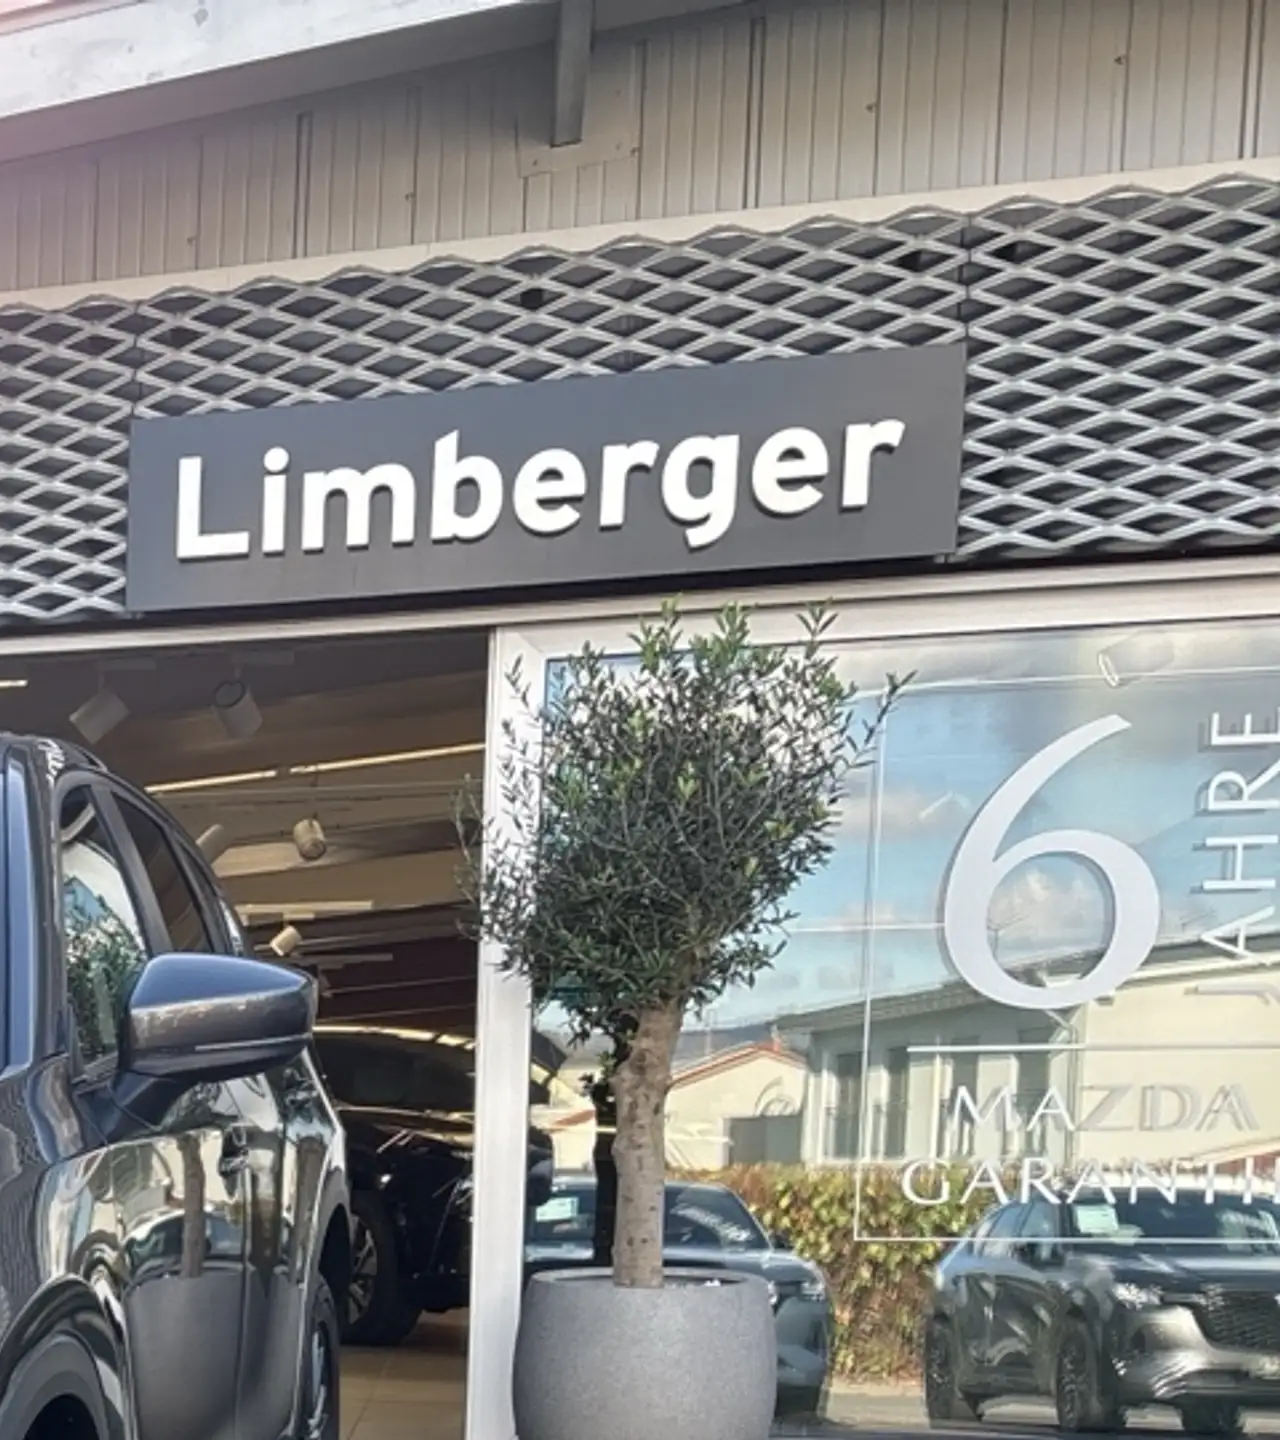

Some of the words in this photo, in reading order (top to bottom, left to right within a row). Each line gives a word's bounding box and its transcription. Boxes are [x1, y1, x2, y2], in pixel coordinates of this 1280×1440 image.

[175, 416, 906, 559] Limberger
[944, 713, 1160, 1010] 6
[950, 1083, 1258, 1132] MAZDA
